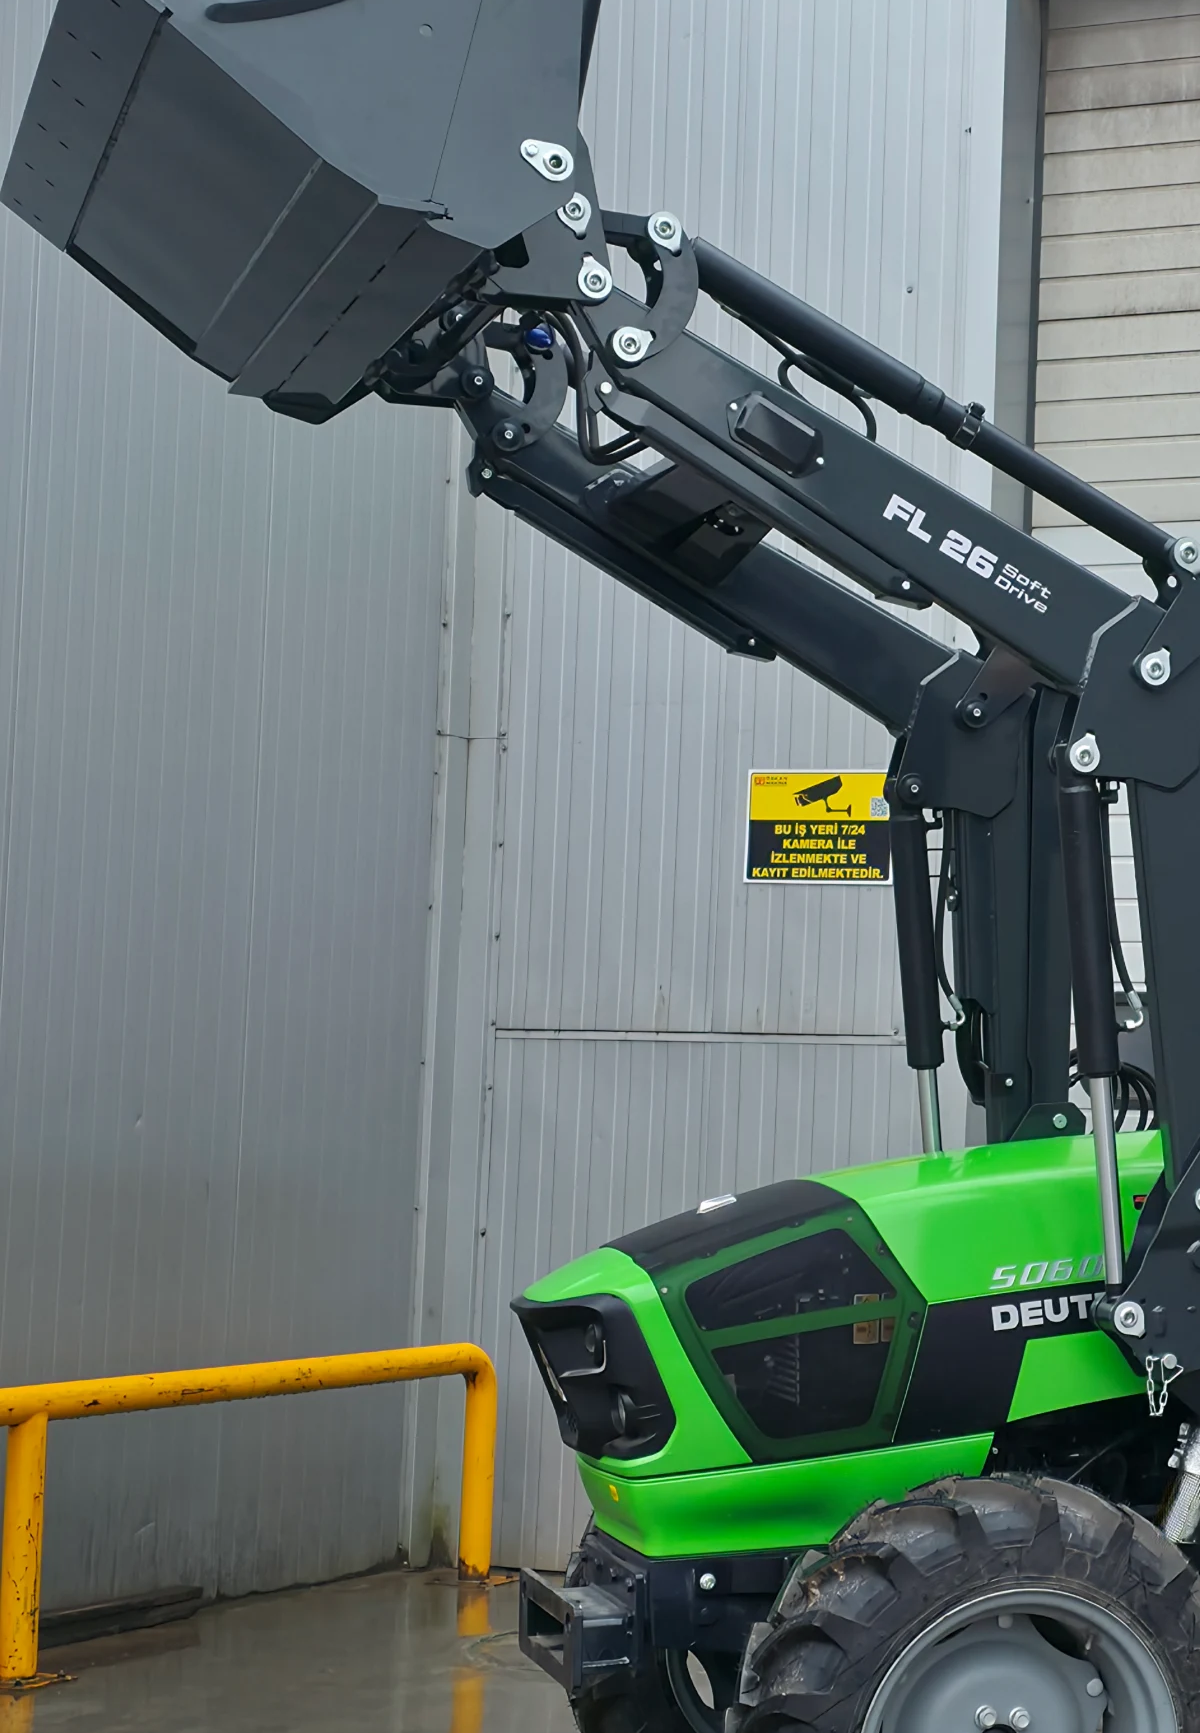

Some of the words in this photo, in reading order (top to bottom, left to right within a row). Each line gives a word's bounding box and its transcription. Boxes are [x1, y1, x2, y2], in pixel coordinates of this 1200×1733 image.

[882, 493, 932, 543] FL
[939, 529, 999, 579] 26
[1002, 563, 1052, 600] Soft
[994, 575, 1048, 613] Drive
[774, 824, 792, 835] BU
[795, 822, 807, 837] İŞ
[810, 822, 838, 835] YERİ
[841, 824, 866, 835] 7/24
[782, 839, 833, 849] KAMERA
[837, 837, 856, 849] İLE
[770, 851, 847, 864] İZLENMEKTE
[851, 854, 867, 864] VE
[752, 867, 789, 878] KAYIT
[791, 866, 884, 879] EDİLMEKTEDİR.
